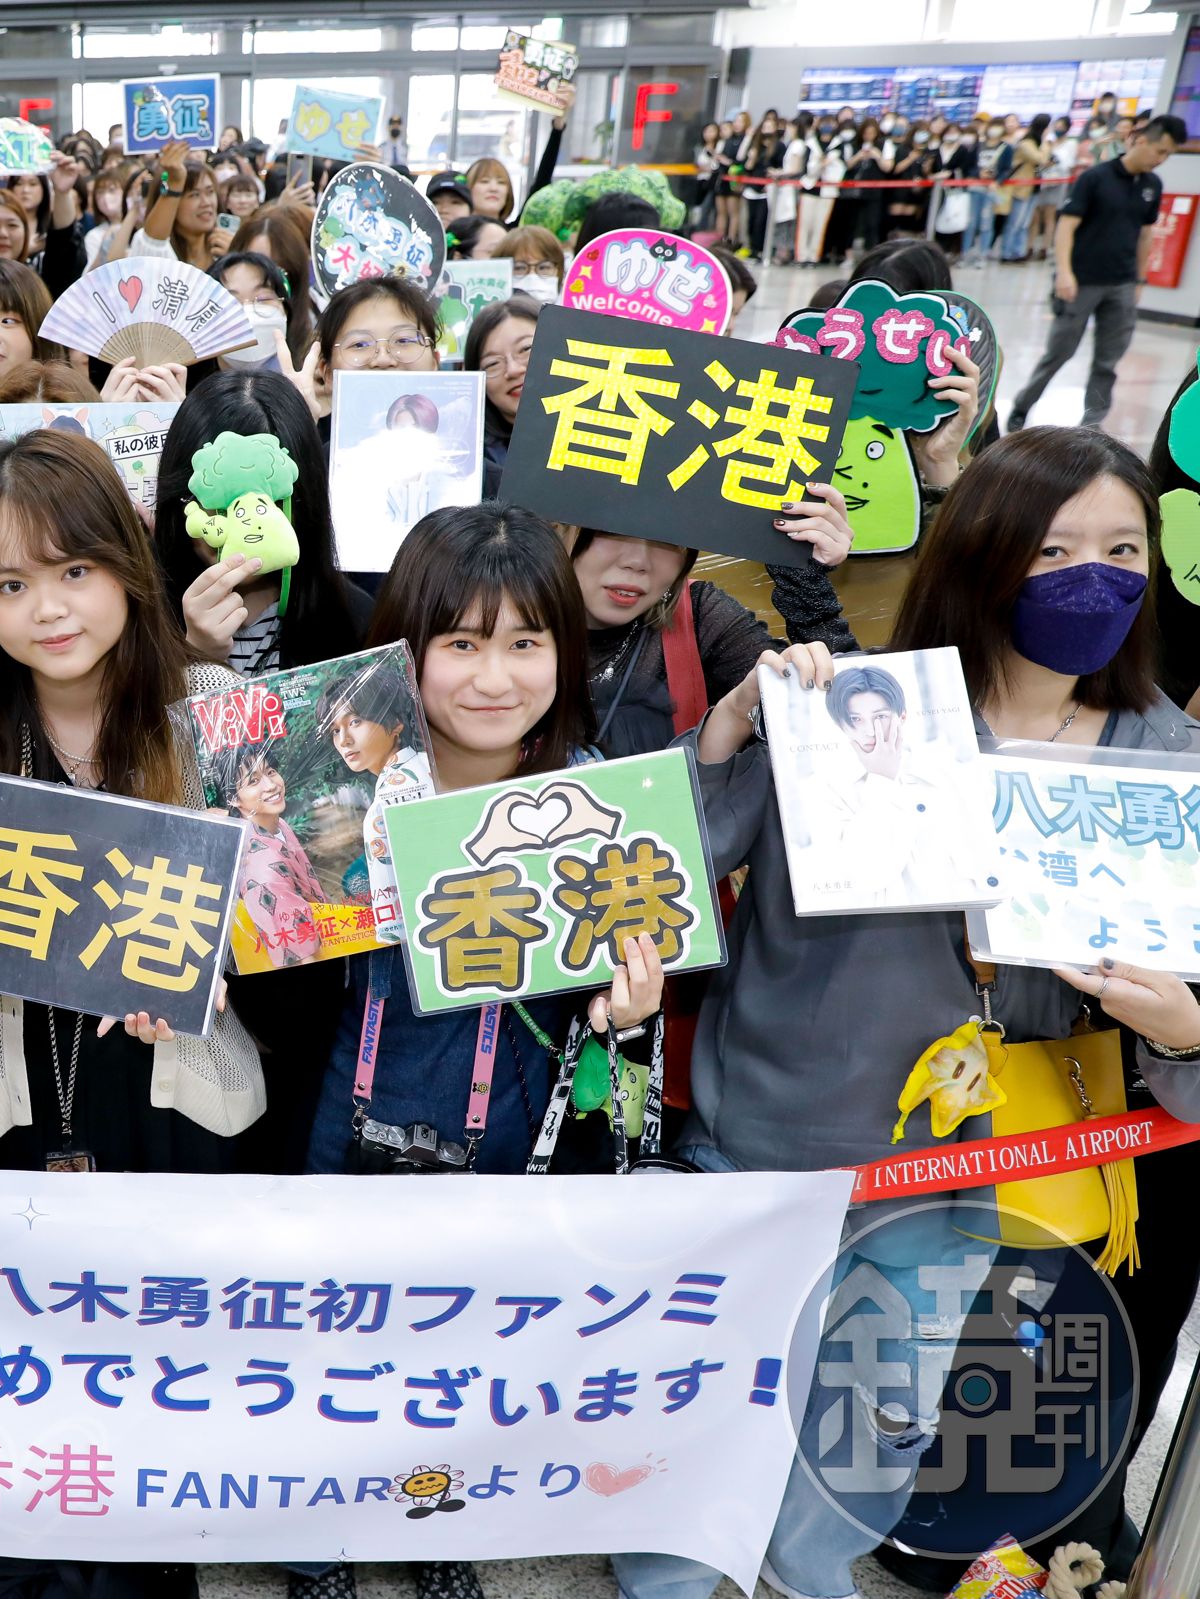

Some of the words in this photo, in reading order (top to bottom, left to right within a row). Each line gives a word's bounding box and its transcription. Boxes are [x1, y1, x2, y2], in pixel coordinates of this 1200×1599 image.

[137, 98, 205, 138] 勇征
[604, 239, 712, 314] ゆせ
[572, 294, 673, 327] Welcome
[541, 338, 834, 511] 香港
[282, 686, 306, 699] TWS
[193, 687, 285, 752] ViVi
[789, 742, 841, 753] CONTACT
[1000, 846, 1126, 888] 湾へ
[421, 839, 692, 991] 香港
[874, 1141, 1057, 1188] INTERNATIONAL
[1065, 1121, 1153, 1161] AIRPORT
[467, 1461, 582, 1501] より
